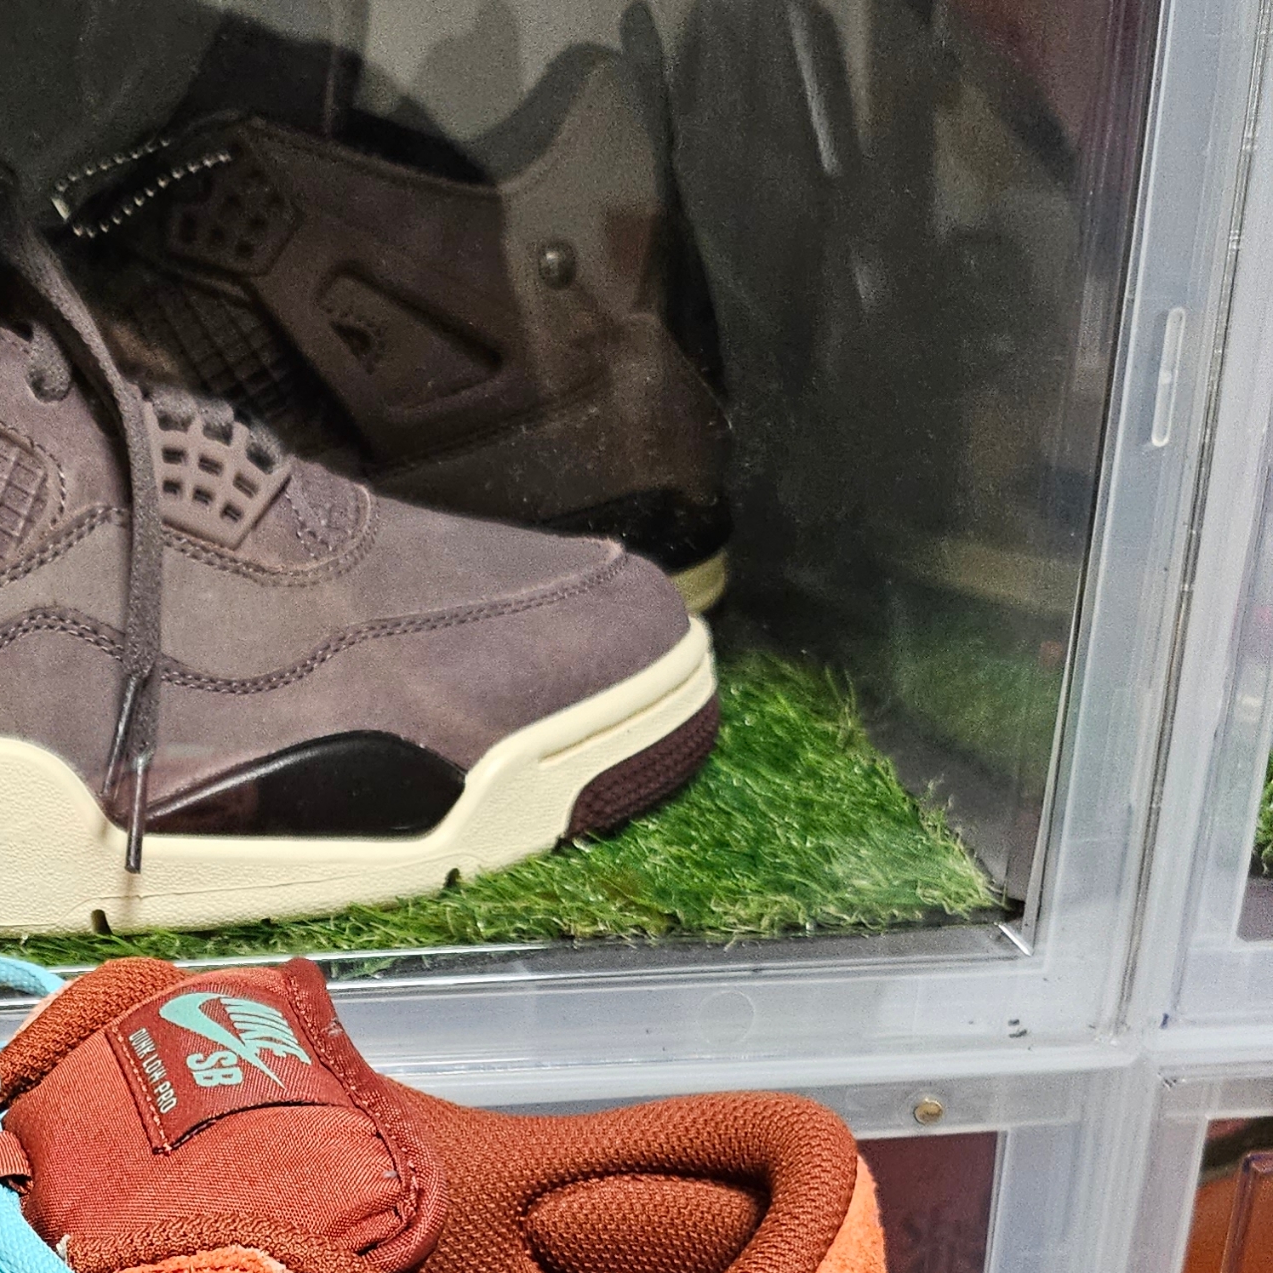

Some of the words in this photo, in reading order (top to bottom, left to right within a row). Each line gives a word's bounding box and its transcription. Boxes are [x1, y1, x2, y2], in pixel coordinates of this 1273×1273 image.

[128, 1027, 156, 1060] DUNK
[218, 995, 312, 1065] NIKE
[142, 1053, 167, 1085] LOW
[186, 1050, 244, 1088] SB
[153, 1080, 177, 1114] PRO
